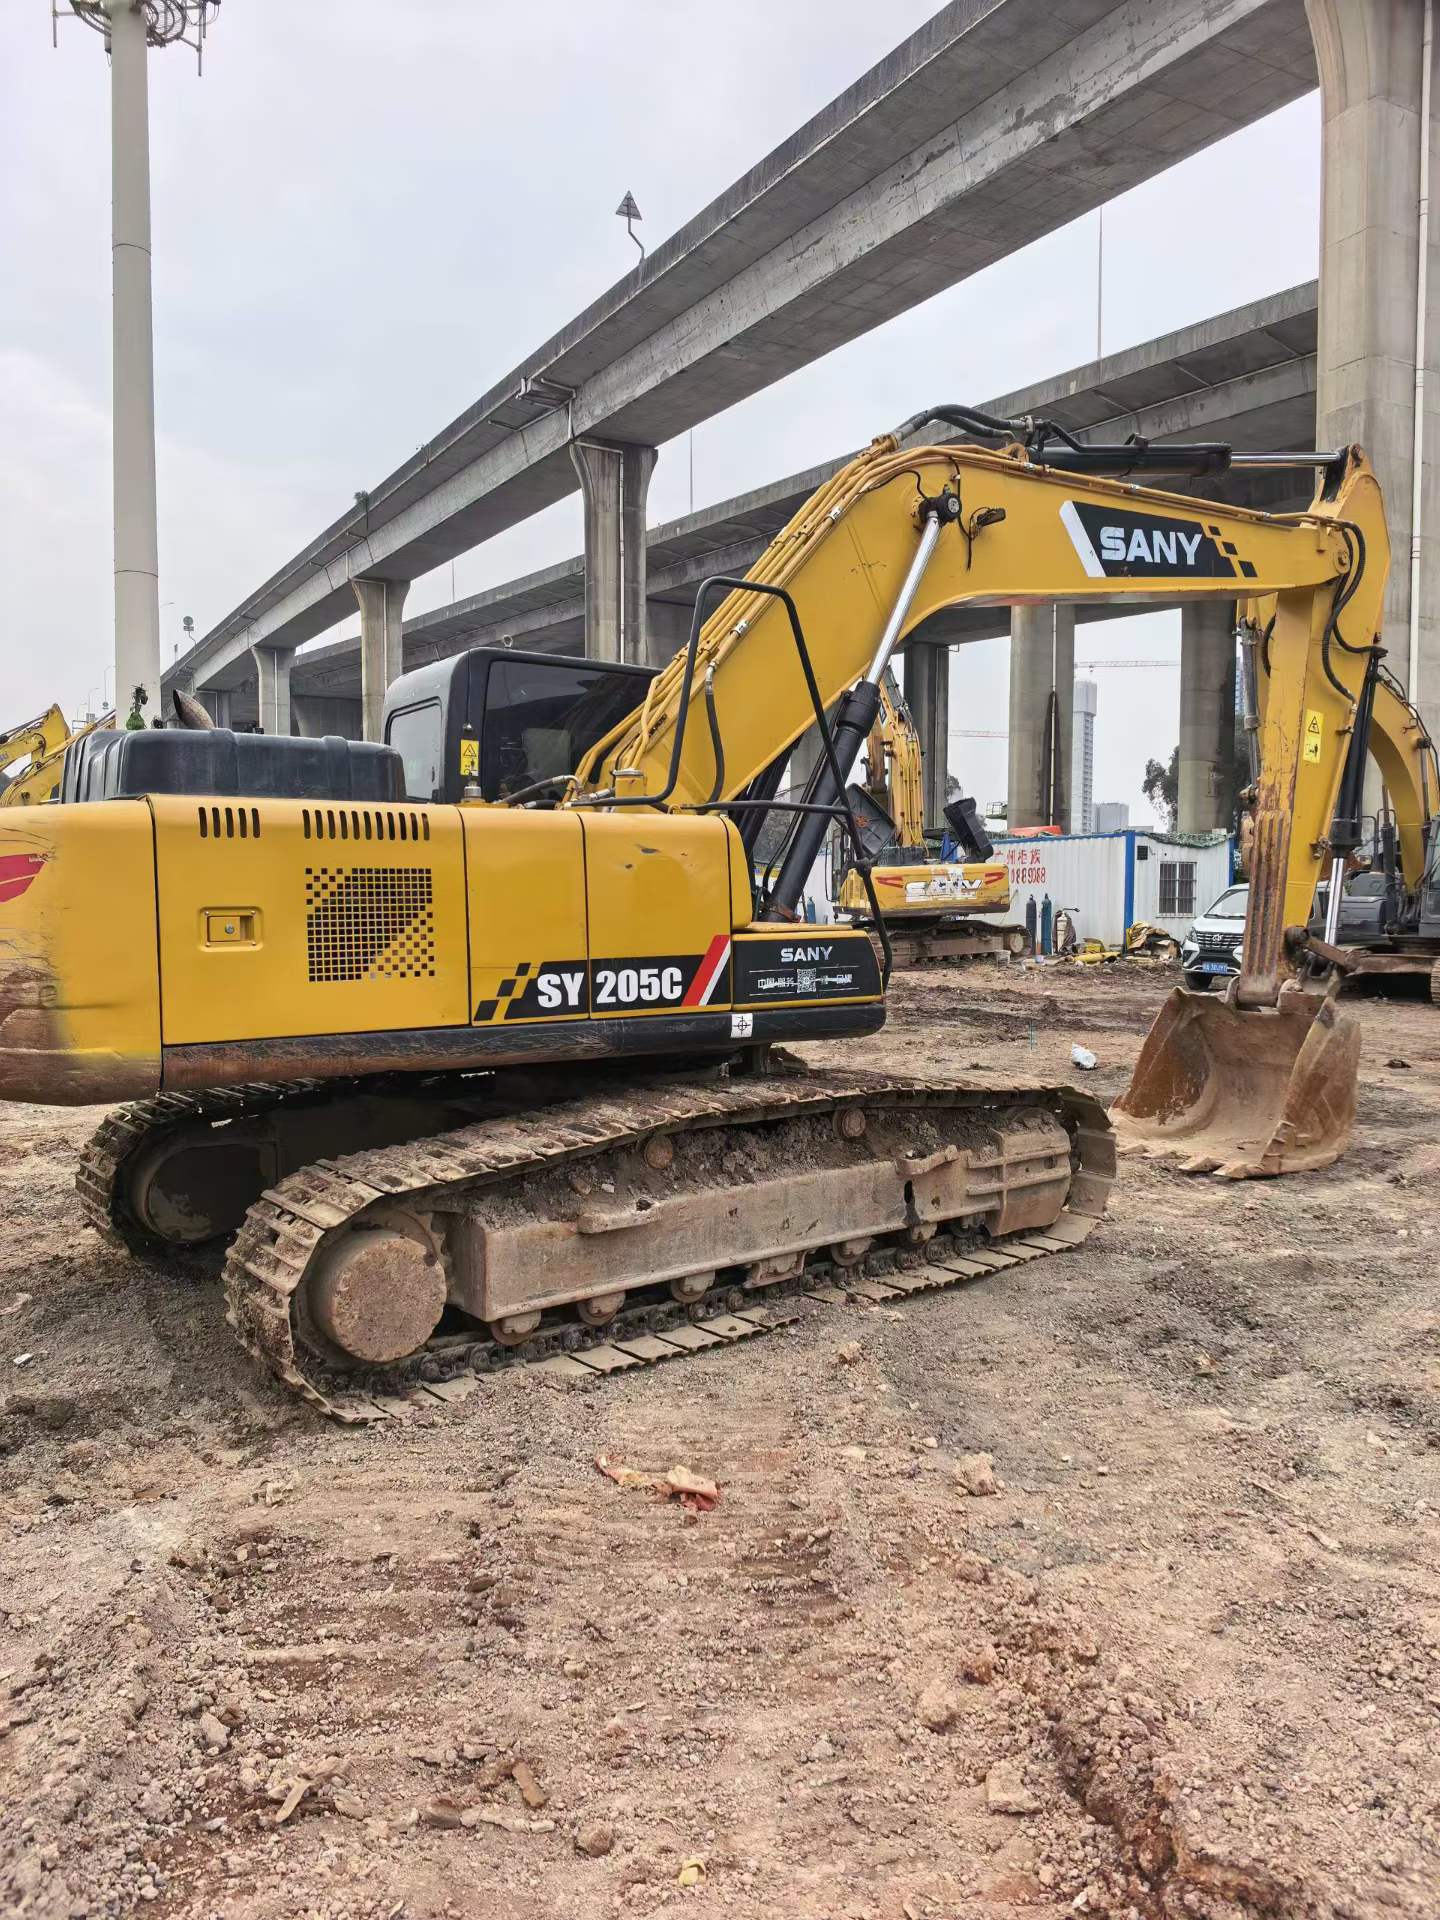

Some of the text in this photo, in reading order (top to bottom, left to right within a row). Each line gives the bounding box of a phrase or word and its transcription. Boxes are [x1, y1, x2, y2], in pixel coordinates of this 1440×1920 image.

[1100, 526, 1202, 565] SANY
[780, 946, 833, 962] SANY
[537, 967, 682, 1008] SY 205C
